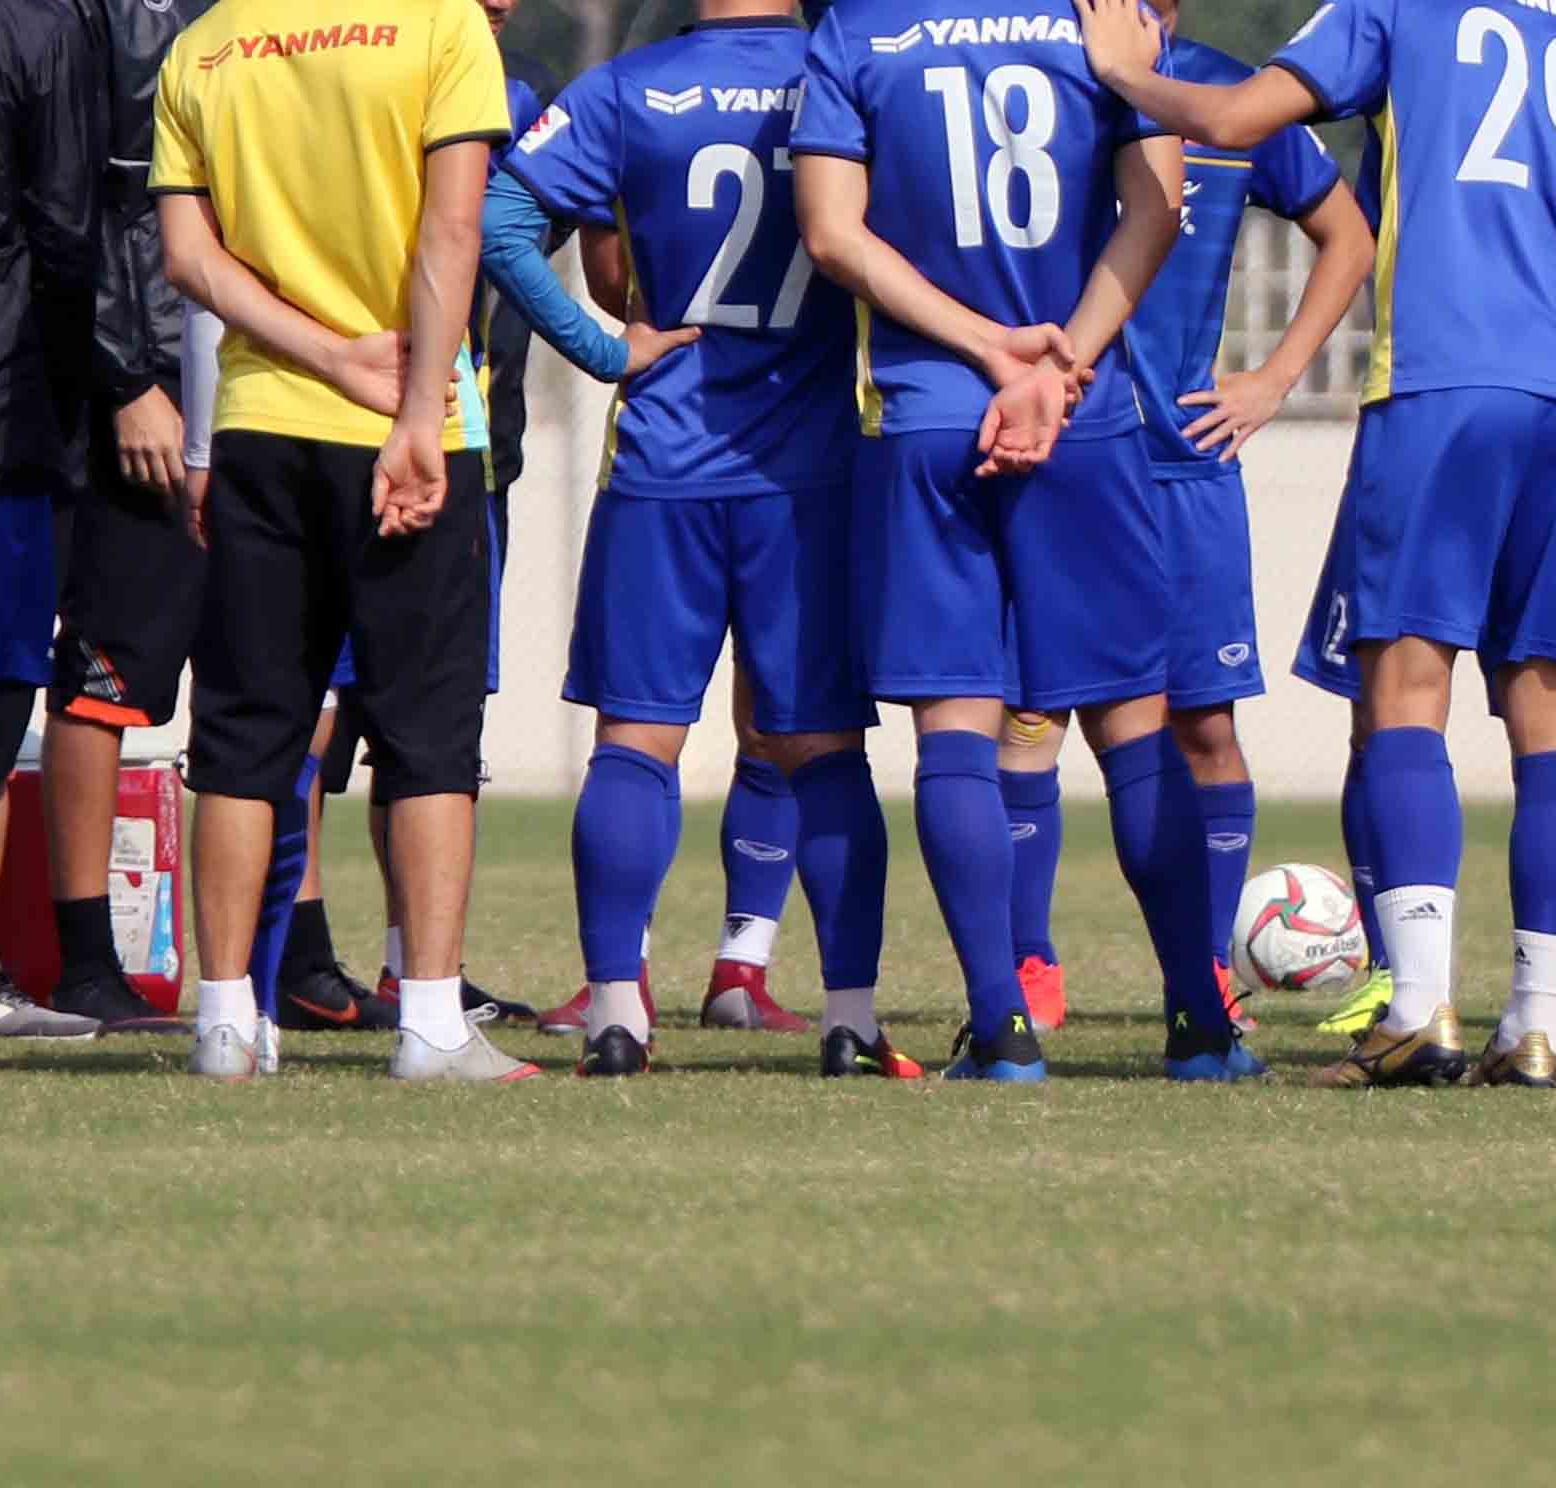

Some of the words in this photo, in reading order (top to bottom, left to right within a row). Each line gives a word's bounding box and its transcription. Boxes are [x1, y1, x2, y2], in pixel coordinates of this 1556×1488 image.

[236, 23, 398, 58] YANMAR
[923, 15, 1085, 46] YANMA
[710, 87, 802, 113] YAN
[923, 64, 1060, 249] 18
